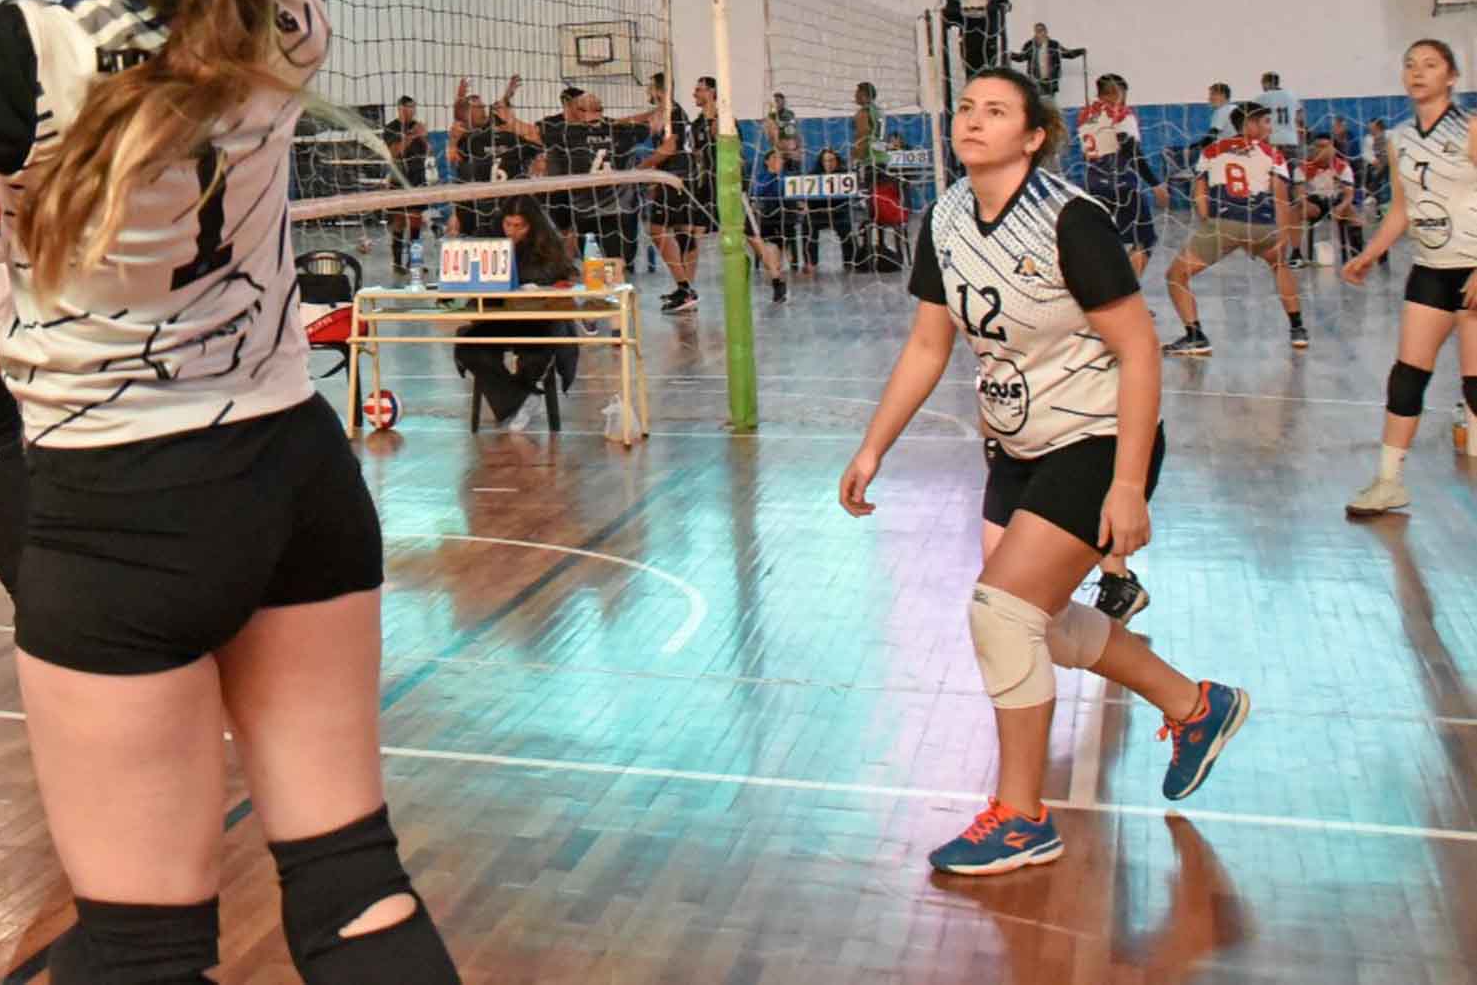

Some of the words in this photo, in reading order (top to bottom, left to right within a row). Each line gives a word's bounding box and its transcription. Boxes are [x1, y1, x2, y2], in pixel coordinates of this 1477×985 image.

[826, 176, 854, 194] 19
[1225, 162, 1250, 198] 8
[1414, 161, 1429, 190] 7
[957, 284, 1008, 342] 12
